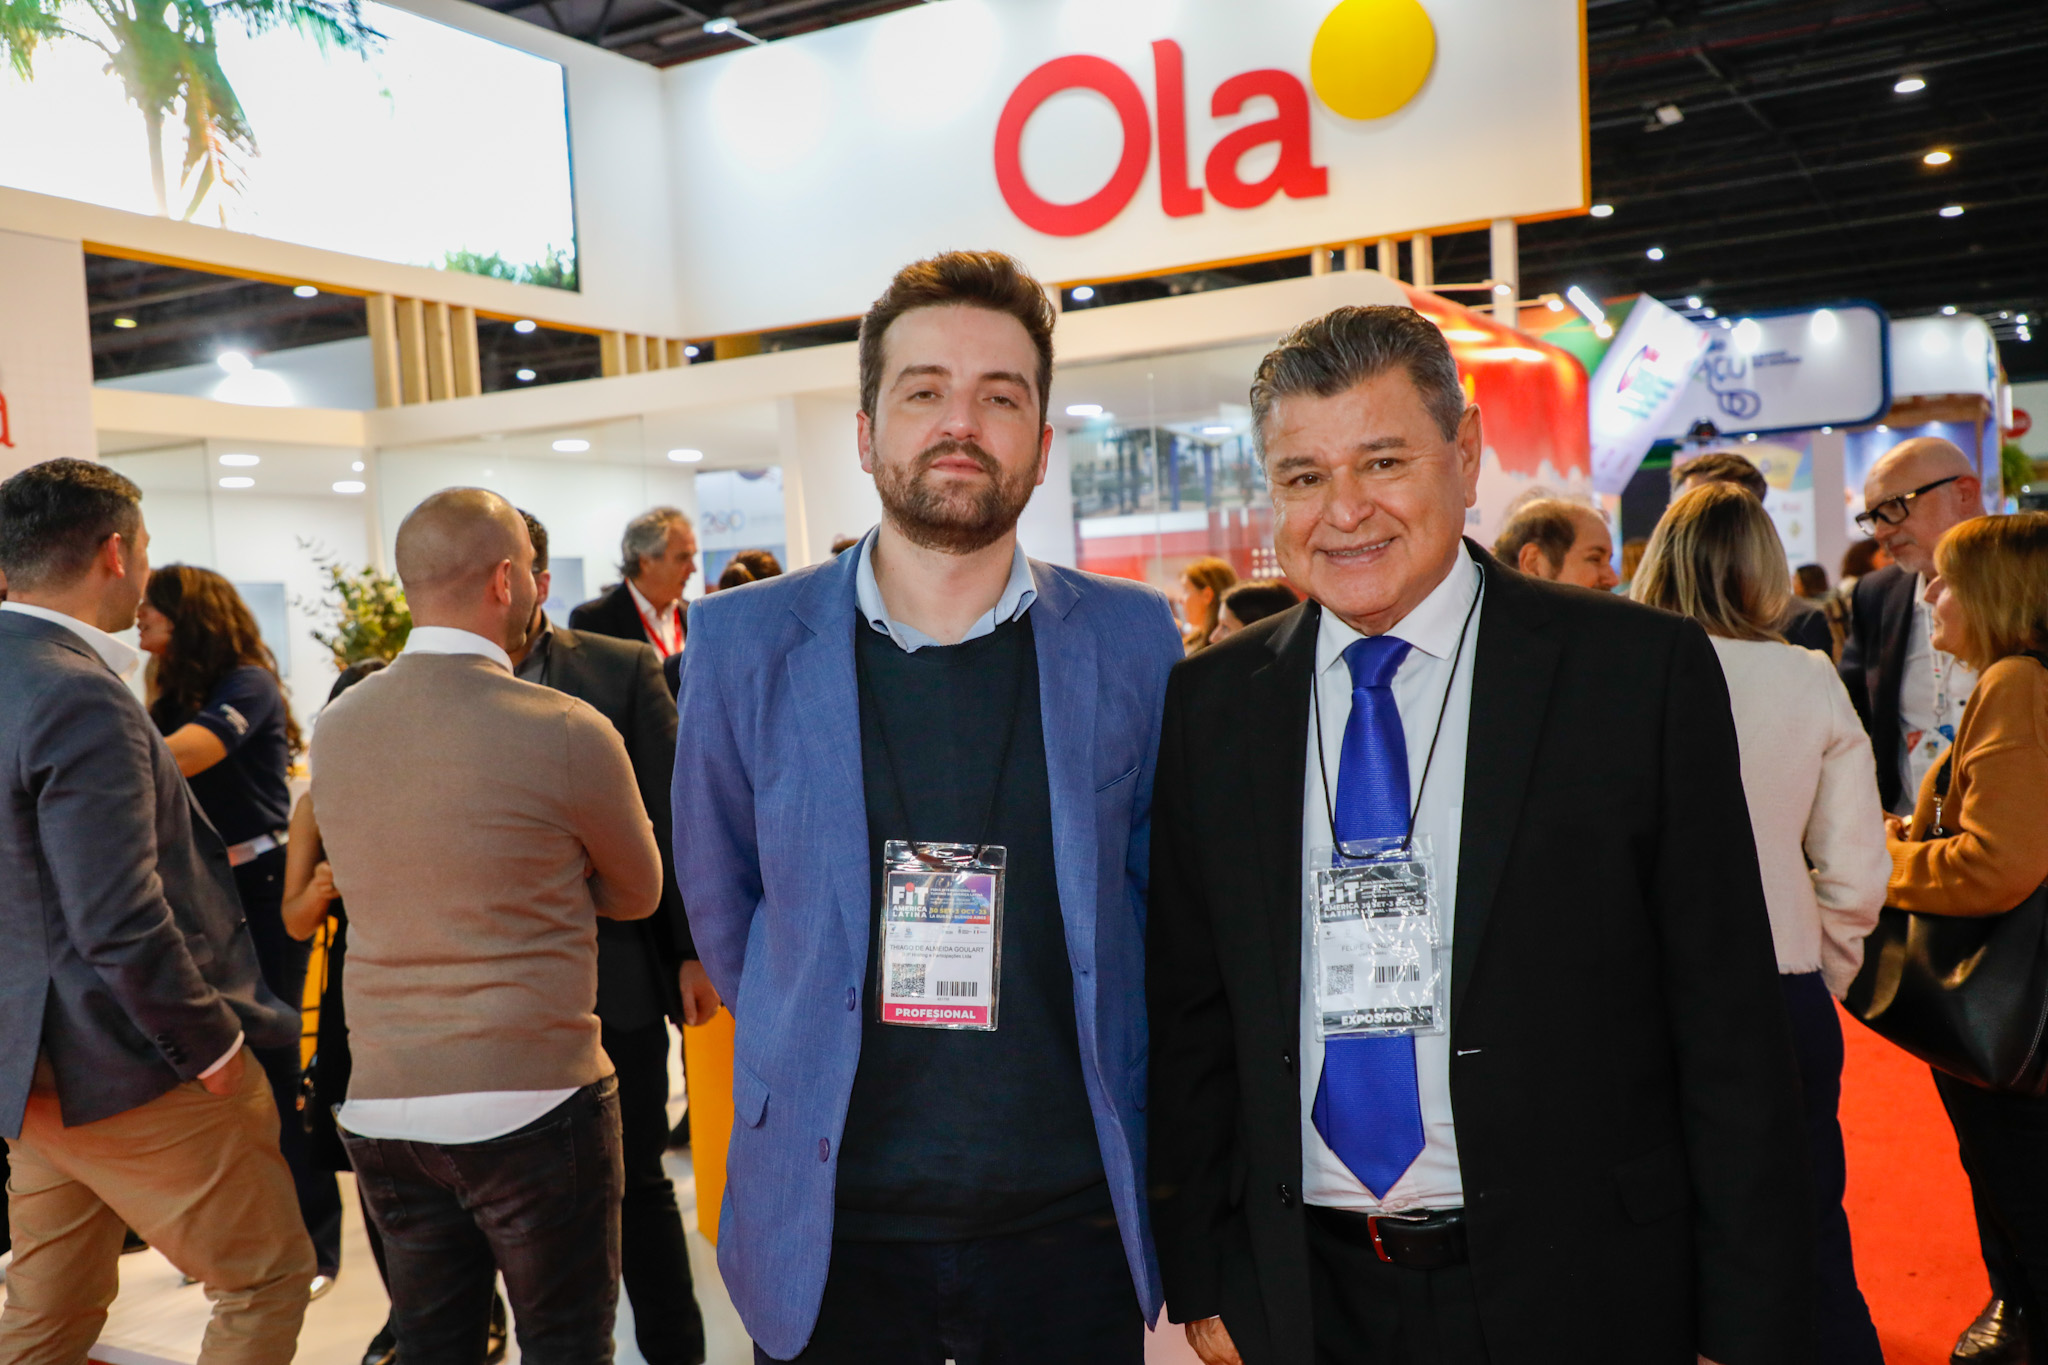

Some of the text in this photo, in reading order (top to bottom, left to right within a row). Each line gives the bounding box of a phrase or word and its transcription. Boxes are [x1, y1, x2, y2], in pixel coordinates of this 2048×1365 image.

[993, 38, 1328, 237] Ola
[1324, 902, 1359, 911] AMERICA
[1324, 909, 1359, 918] LATINA
[895, 1007, 977, 1020] PROFESIONAL
[1341, 1011, 1413, 1026] EXPOSITOR
